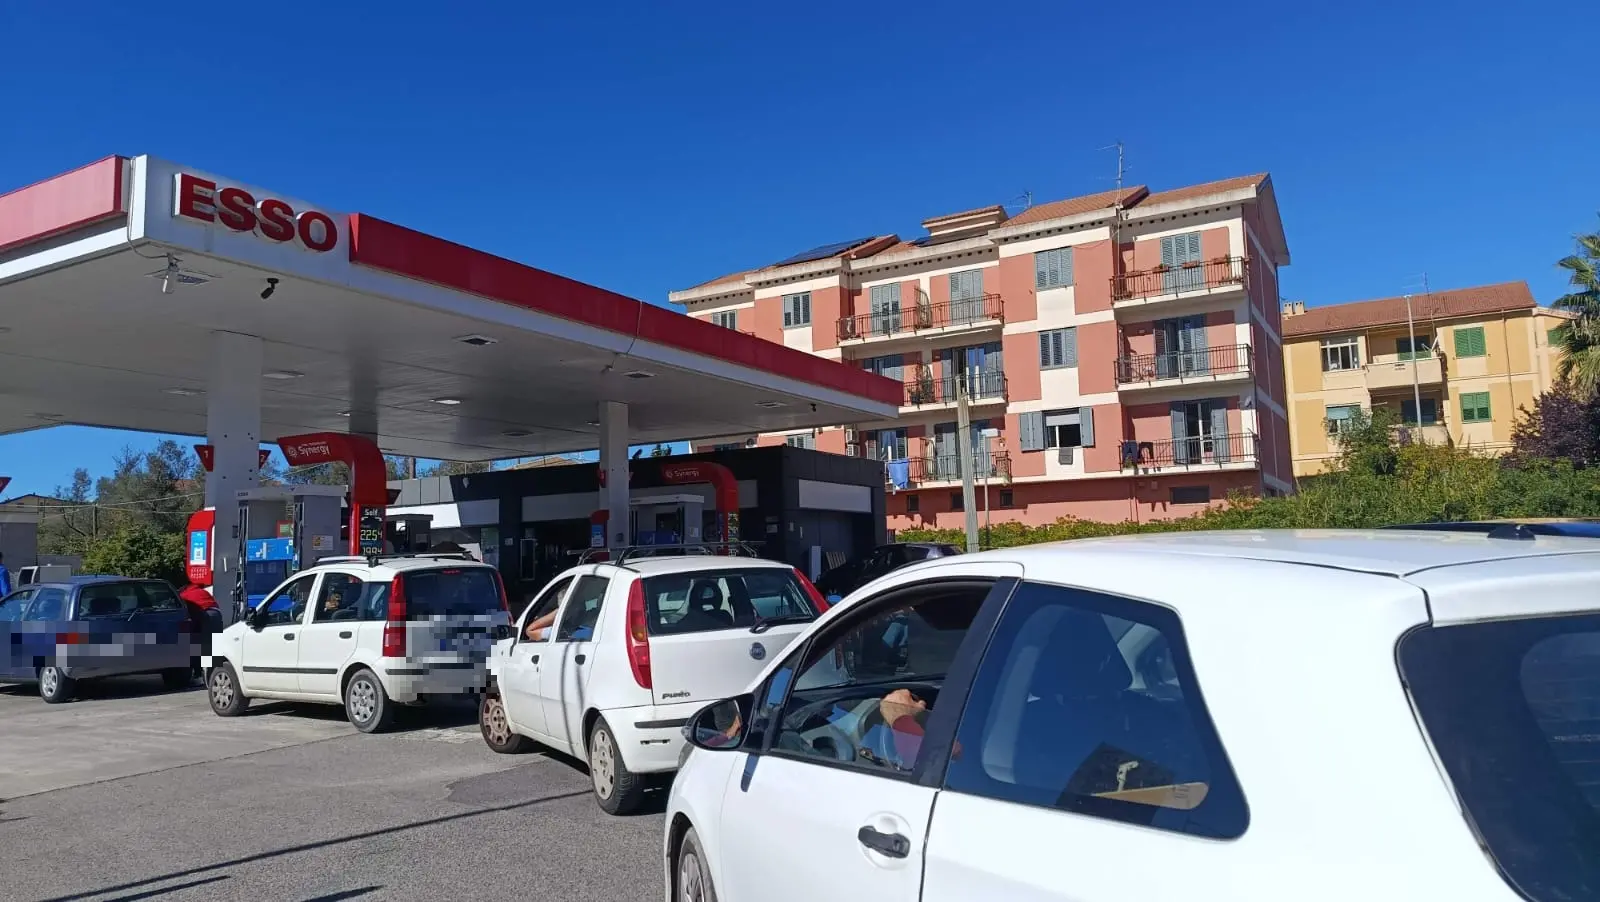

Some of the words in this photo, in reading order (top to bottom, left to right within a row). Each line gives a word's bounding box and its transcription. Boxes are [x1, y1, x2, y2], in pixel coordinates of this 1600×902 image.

[175, 172, 338, 251] ESSO
[298, 446, 330, 456] Synergy
[364, 508, 378, 516] Self
